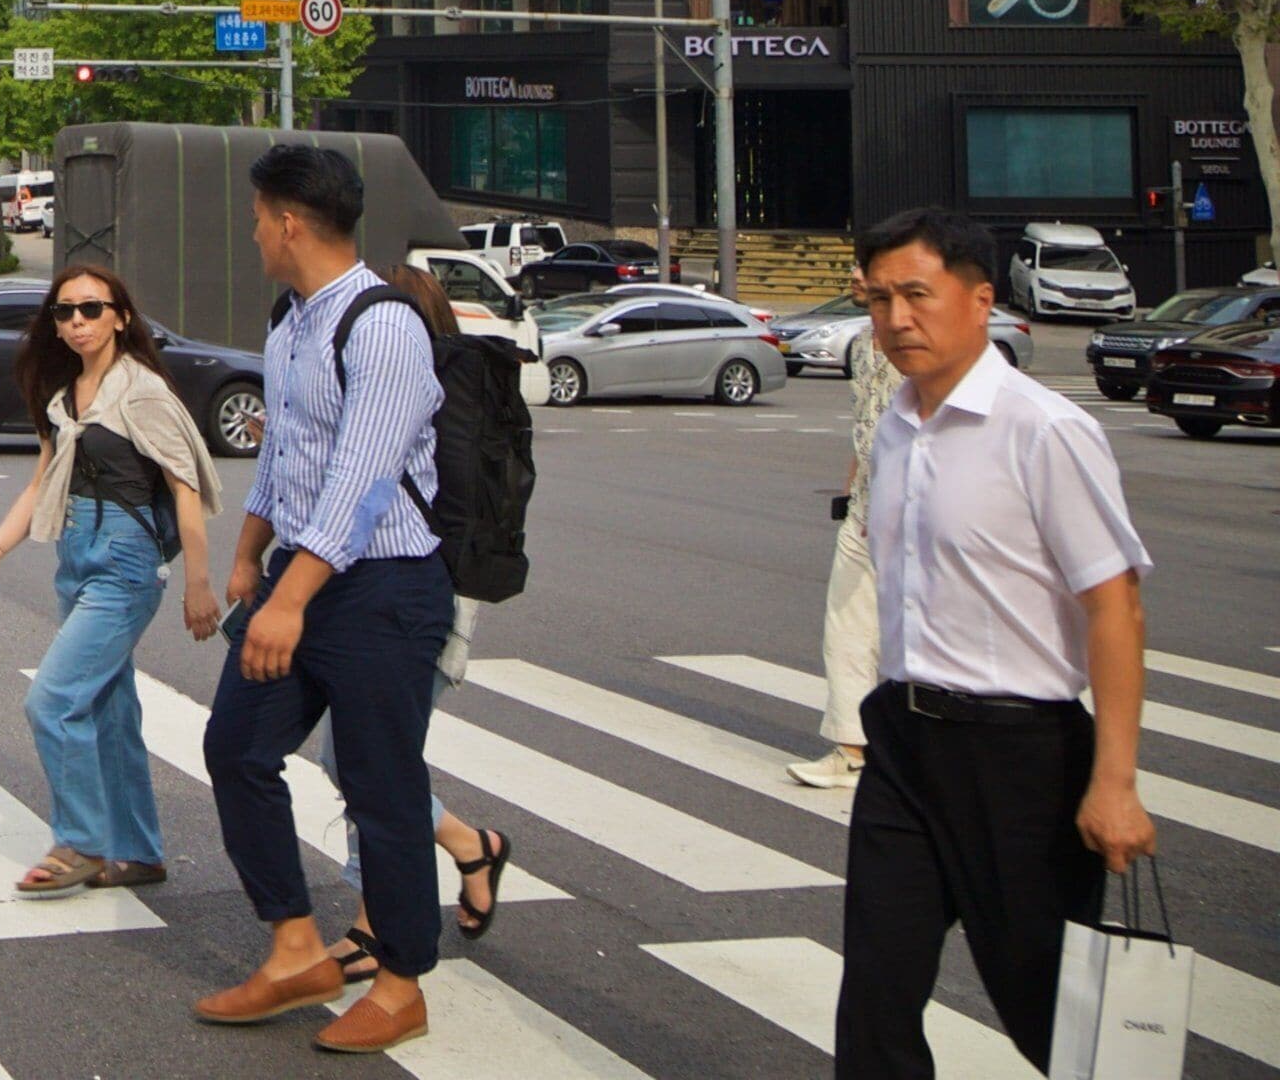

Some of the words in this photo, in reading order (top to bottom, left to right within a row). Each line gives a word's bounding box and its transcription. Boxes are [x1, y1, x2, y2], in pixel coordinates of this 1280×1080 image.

[308, 0, 334, 23] 60
[465, 76, 516, 99] BOTTEGA
[517, 83, 555, 100] LOUNGE
[1174, 120, 1253, 135] BOTTEGA
[1191, 138, 1241, 149] LOUNGE
[1200, 164, 1231, 175] SEOUL
[1123, 1019, 1167, 1036] CHANEL
